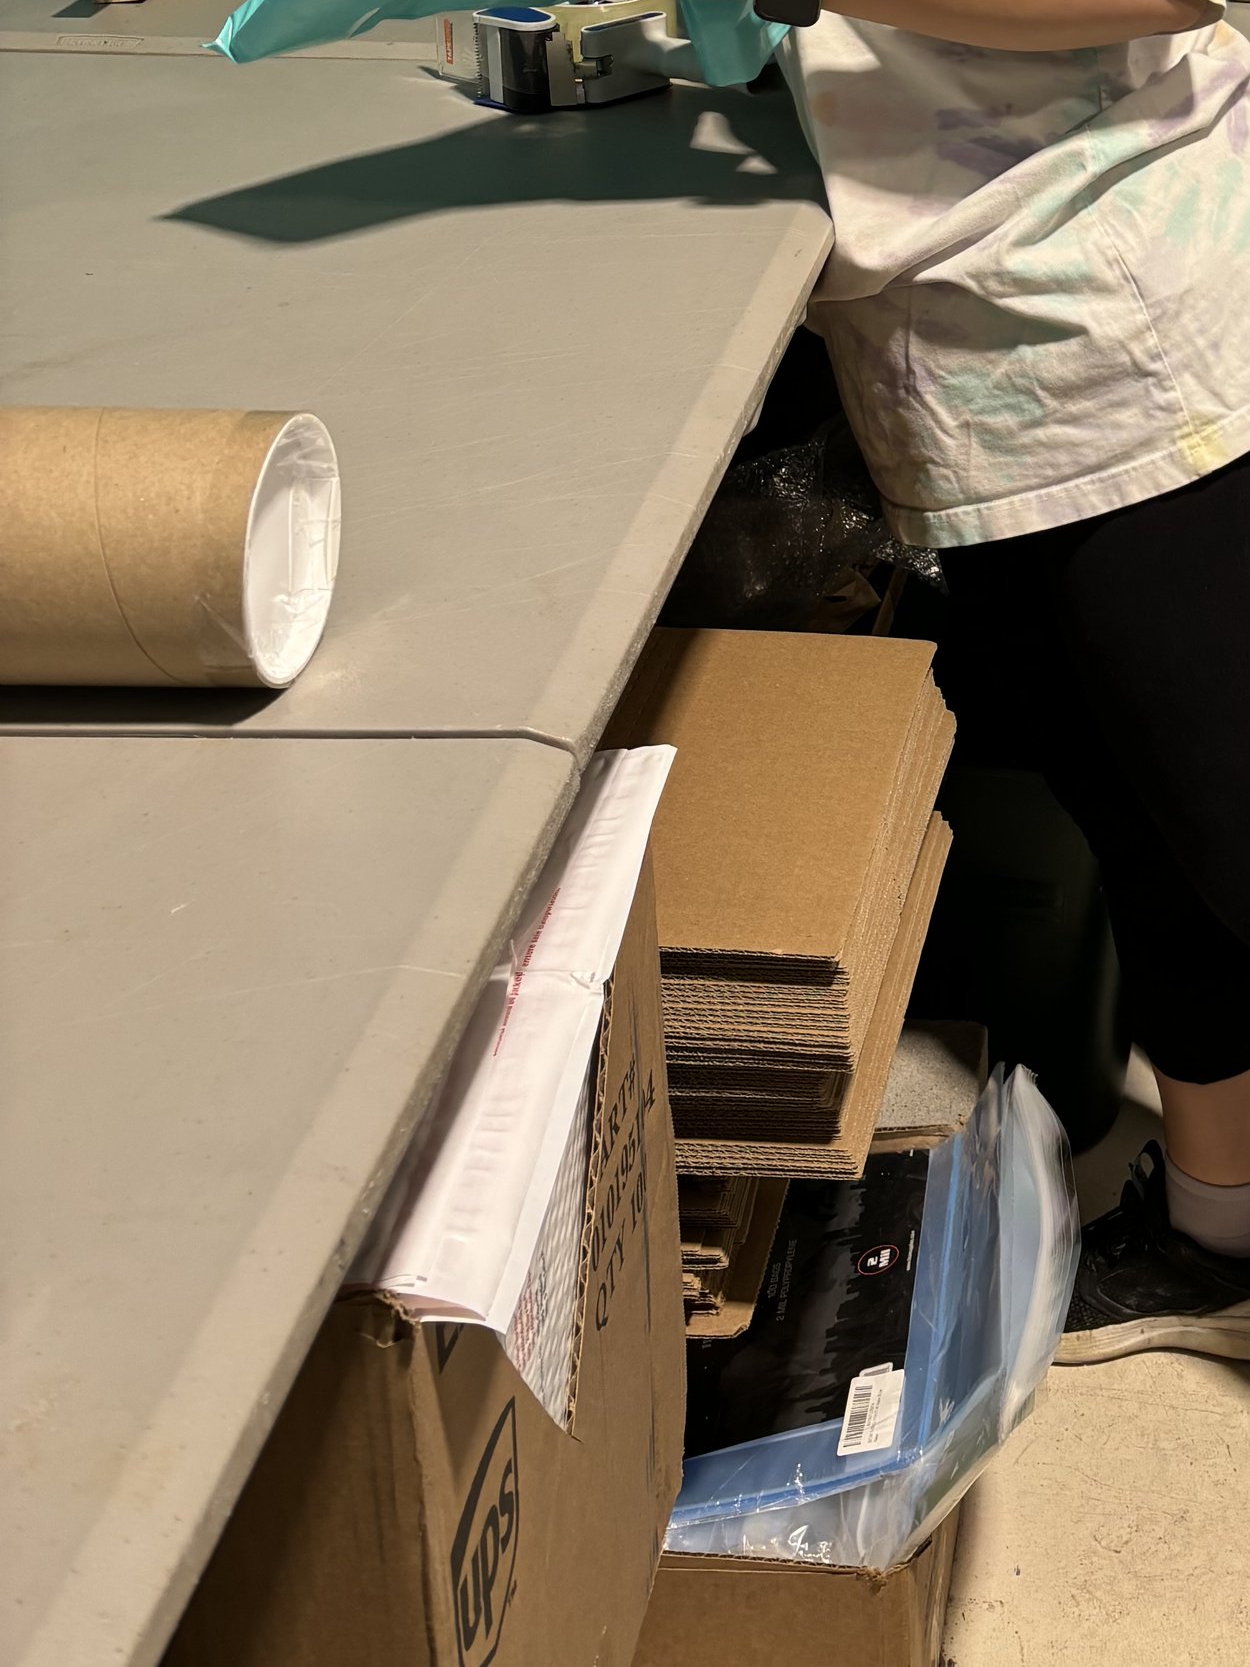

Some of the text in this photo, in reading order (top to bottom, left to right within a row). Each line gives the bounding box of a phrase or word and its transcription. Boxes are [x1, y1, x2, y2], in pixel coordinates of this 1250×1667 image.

[599, 1060, 636, 1181] ART#
[595, 1219, 625, 1331] QTY
[867, 1256, 878, 1267] 2
[878, 1248, 891, 1268] Mil
[460, 1458, 515, 1652] UPS
